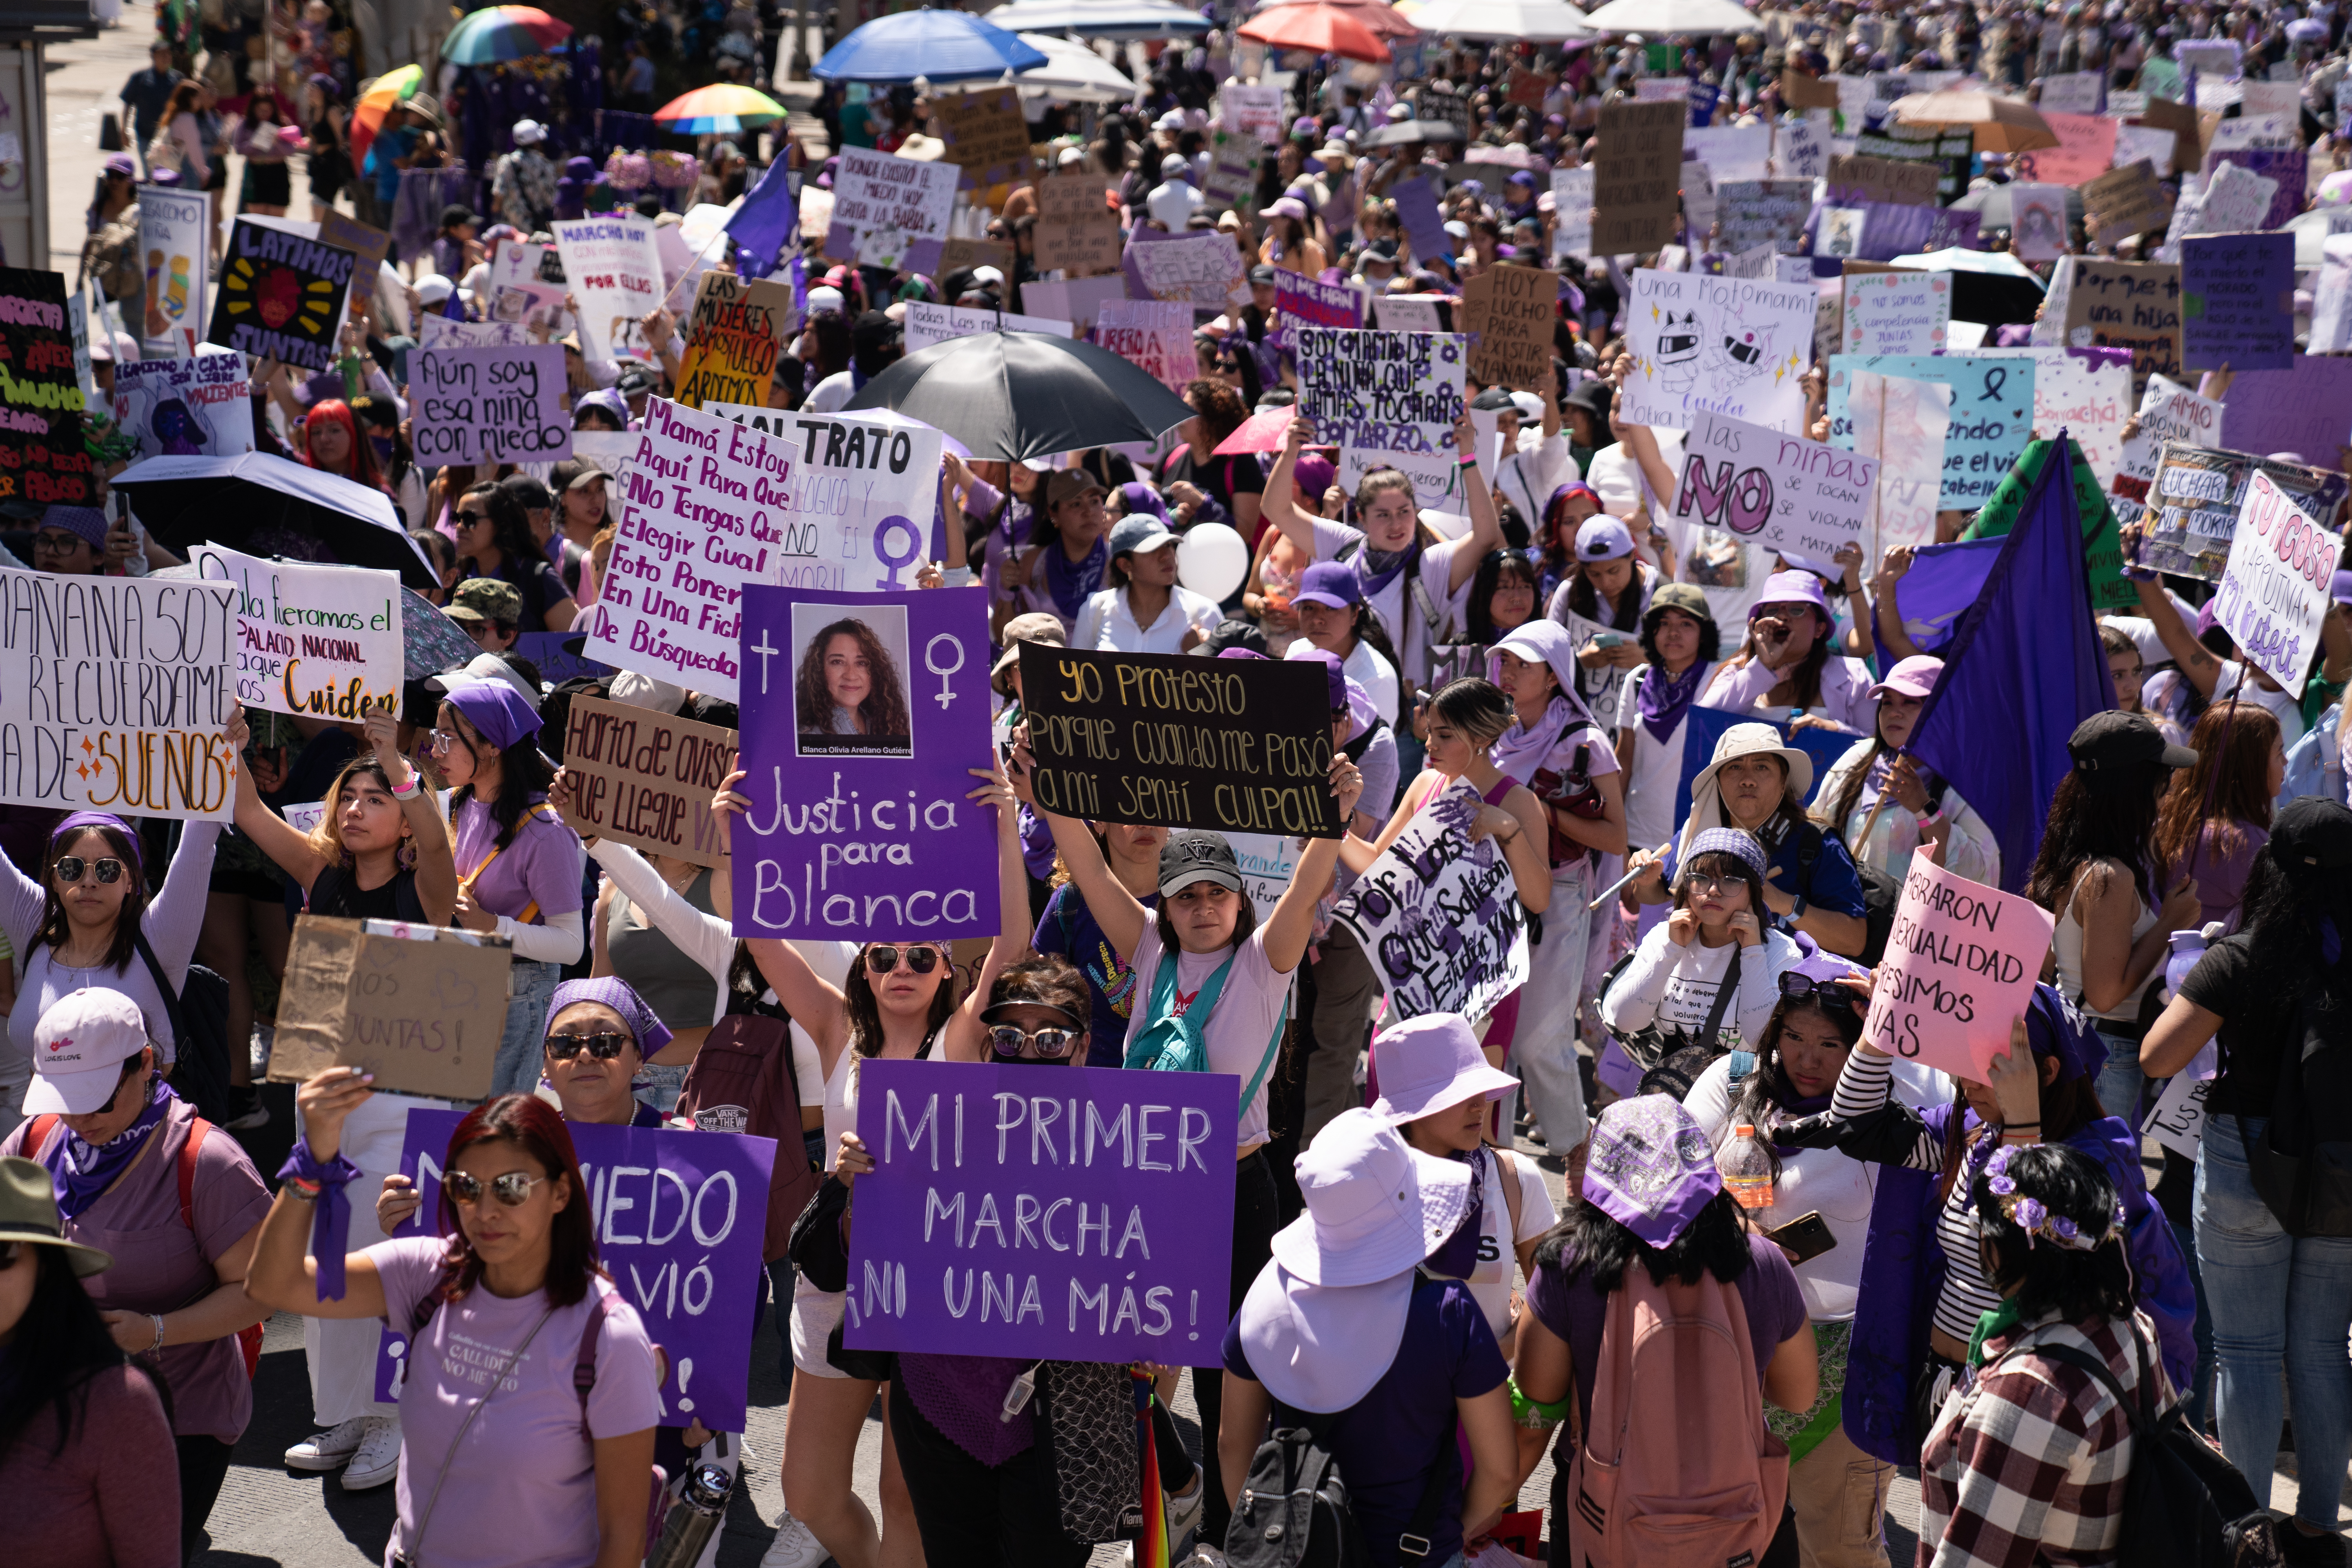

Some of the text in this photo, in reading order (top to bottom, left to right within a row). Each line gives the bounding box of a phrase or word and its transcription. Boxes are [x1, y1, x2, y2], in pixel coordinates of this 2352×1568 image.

[706, 276, 736, 299] LAS
[1492, 268, 1541, 298] HOY
[1698, 277, 1817, 314] Motomami
[696, 298, 776, 340] MUJERES
[909, 303, 975, 330] Todas Las
[1121, 301, 1193, 329] SISTEMA
[1487, 316, 1530, 339] PARA
[1491, 296, 1548, 321] LUCHO
[198, 353, 241, 373] CASA
[229, 323, 330, 372] JUNTAS
[1300, 330, 1338, 358] SOY
[1406, 334, 1433, 363] DE
[416, 351, 538, 399] Aún soy
[1304, 359, 1327, 389] LA
[1385, 363, 1421, 393] QUE
[425, 388, 541, 428] esa niña
[417, 419, 566, 461] con miedo
[644, 397, 789, 483] Mamá Estoy
[1704, 416, 1872, 486] las niñas
[1969, 450, 1989, 471] el
[634, 436, 693, 481] Aquí
[699, 455, 748, 501] Para
[753, 477, 790, 510] Que
[1816, 482, 1859, 503] TOCAN
[2161, 469, 2224, 500] LUCHAR
[627, 473, 664, 510] No
[671, 484, 745, 537] Tengas
[750, 510, 784, 545] Que
[1676, 454, 1774, 535] NO
[619, 506, 768, 573] Elegir Cual
[784, 523, 858, 559] NO ES
[1808, 510, 1862, 531] VIOLAN
[2188, 510, 2234, 540] MORIR
[2249, 475, 2279, 535] TU
[2269, 505, 2336, 590] ACOSO
[610, 543, 742, 606] Foto Poner
[271, 574, 391, 632] fueramos el
[602, 572, 689, 625] En Una
[148, 586, 235, 664] SOY
[592, 605, 739, 680] De Búsqueda
[301, 633, 367, 664] NACIONAL
[29, 655, 231, 728] RECUERDAME
[283, 658, 400, 720] Cuiden
[566, 707, 672, 777] Harta de
[802, 746, 882, 755] Blanca Olivia Arellano
[1132, 720, 1260, 776] cuando me
[34, 725, 227, 813] DE SUEÑOS
[565, 769, 606, 824] que
[745, 765, 958, 835] Justicia
[1037, 768, 1192, 823] a mi sentí
[820, 841, 914, 891] para
[1180, 839, 1216, 865] NY
[752, 859, 978, 929] Blanca
[1329, 827, 1463, 946] Por Las
[1378, 858, 1510, 980] Que Salieron
[1890, 911, 2023, 984] SEXUALIDAD
[1671, 995, 1682, 1005] las
[1688, 1001, 1701, 1009] que
[1683, 986, 1690, 995] lo
[1673, 1011, 1708, 1022] volviero
[63, 1053, 82, 1062] LOVE
[715, 1109, 739, 1118] VANS
[718, 1117, 735, 1128] THE
[884, 1089, 1212, 1174] MI PRIMER
[2145, 1103, 2199, 1137] Tus
[924, 1186, 1151, 1260] MARCHA
[846, 1259, 1044, 1329] ¡NI UNA
[441, 1357, 466, 1377] NO
[1731, 1555, 1752, 1567] adidas
